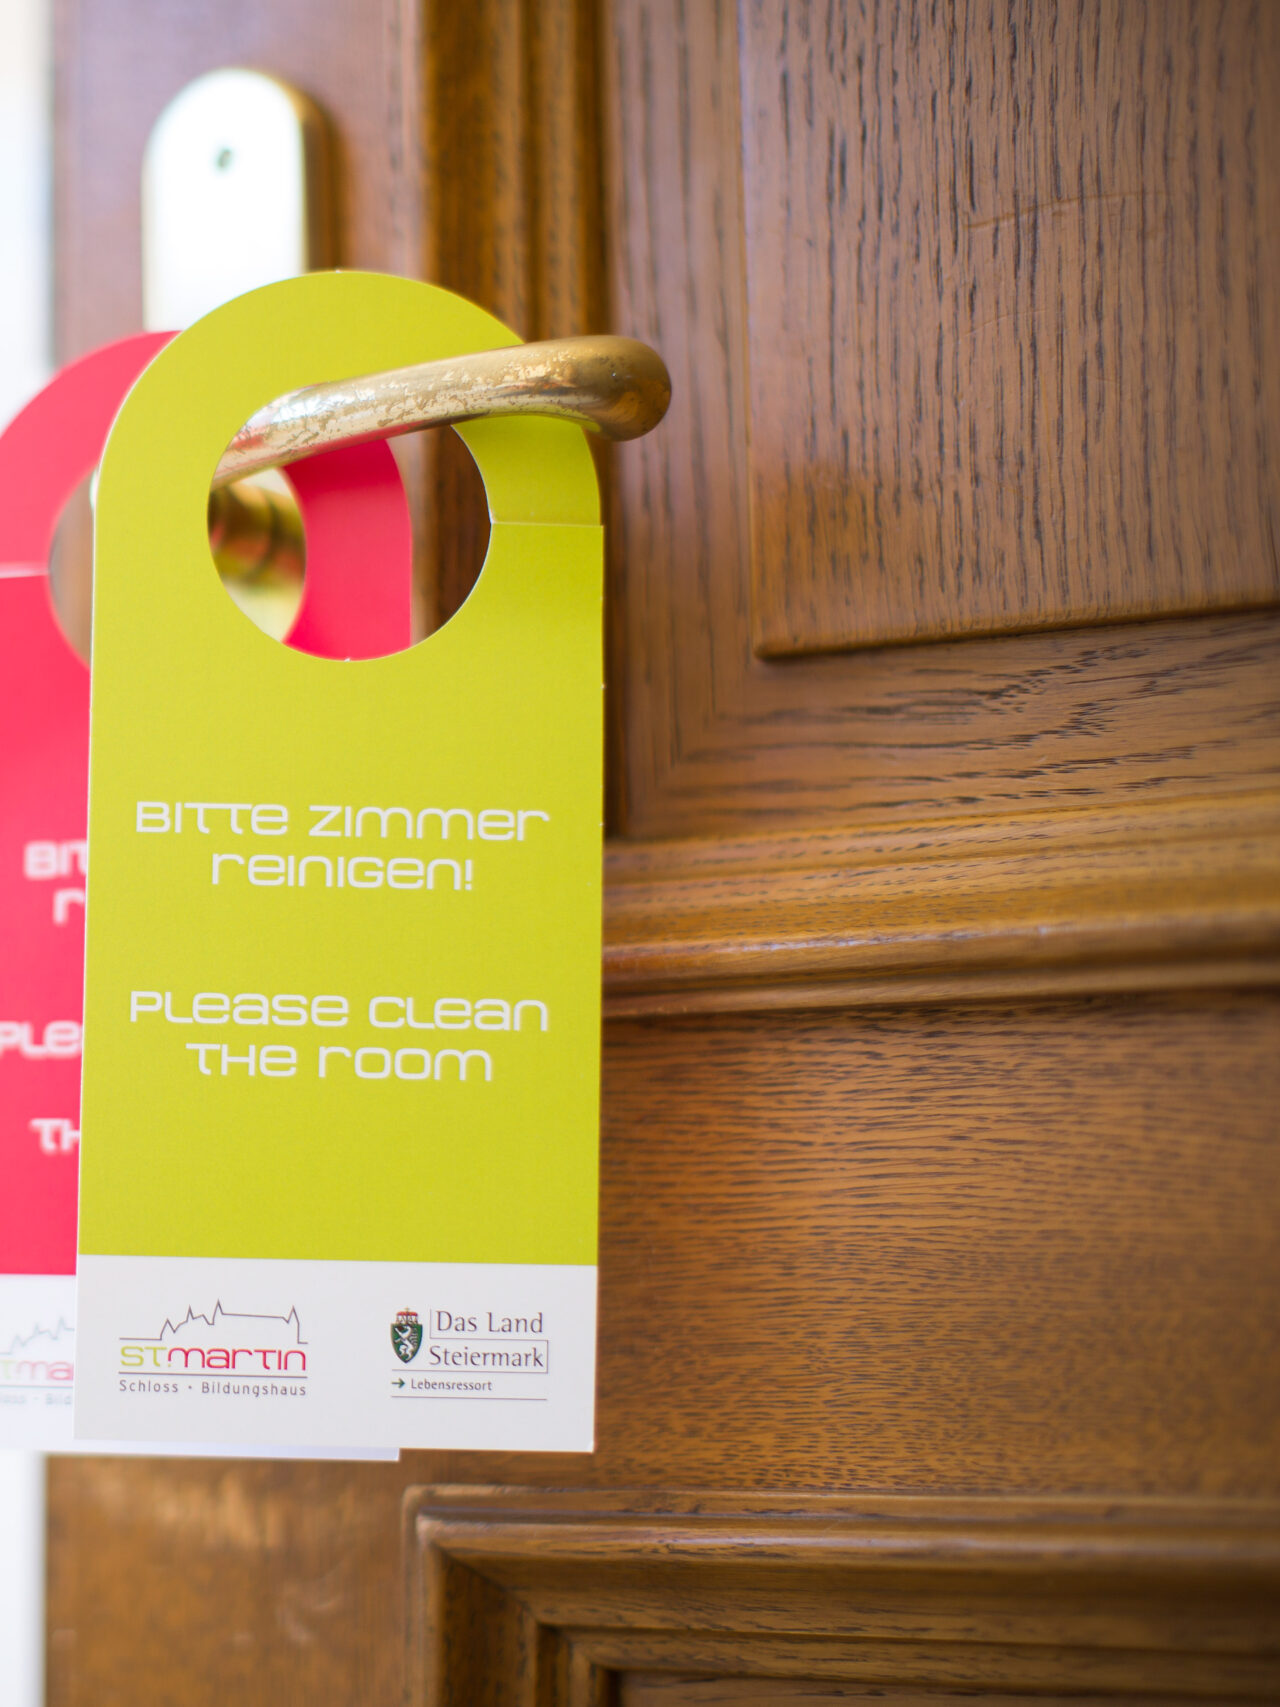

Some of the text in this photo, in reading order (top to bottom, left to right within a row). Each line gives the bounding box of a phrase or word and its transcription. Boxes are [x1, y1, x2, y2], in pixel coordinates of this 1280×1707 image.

[436, 1310, 543, 1333] Das Land
[429, 1345, 544, 1367] Steiermark
[119, 1379, 307, 1398] Schloss Bildungshaus
[410, 1377, 493, 1391] Lebensressort
